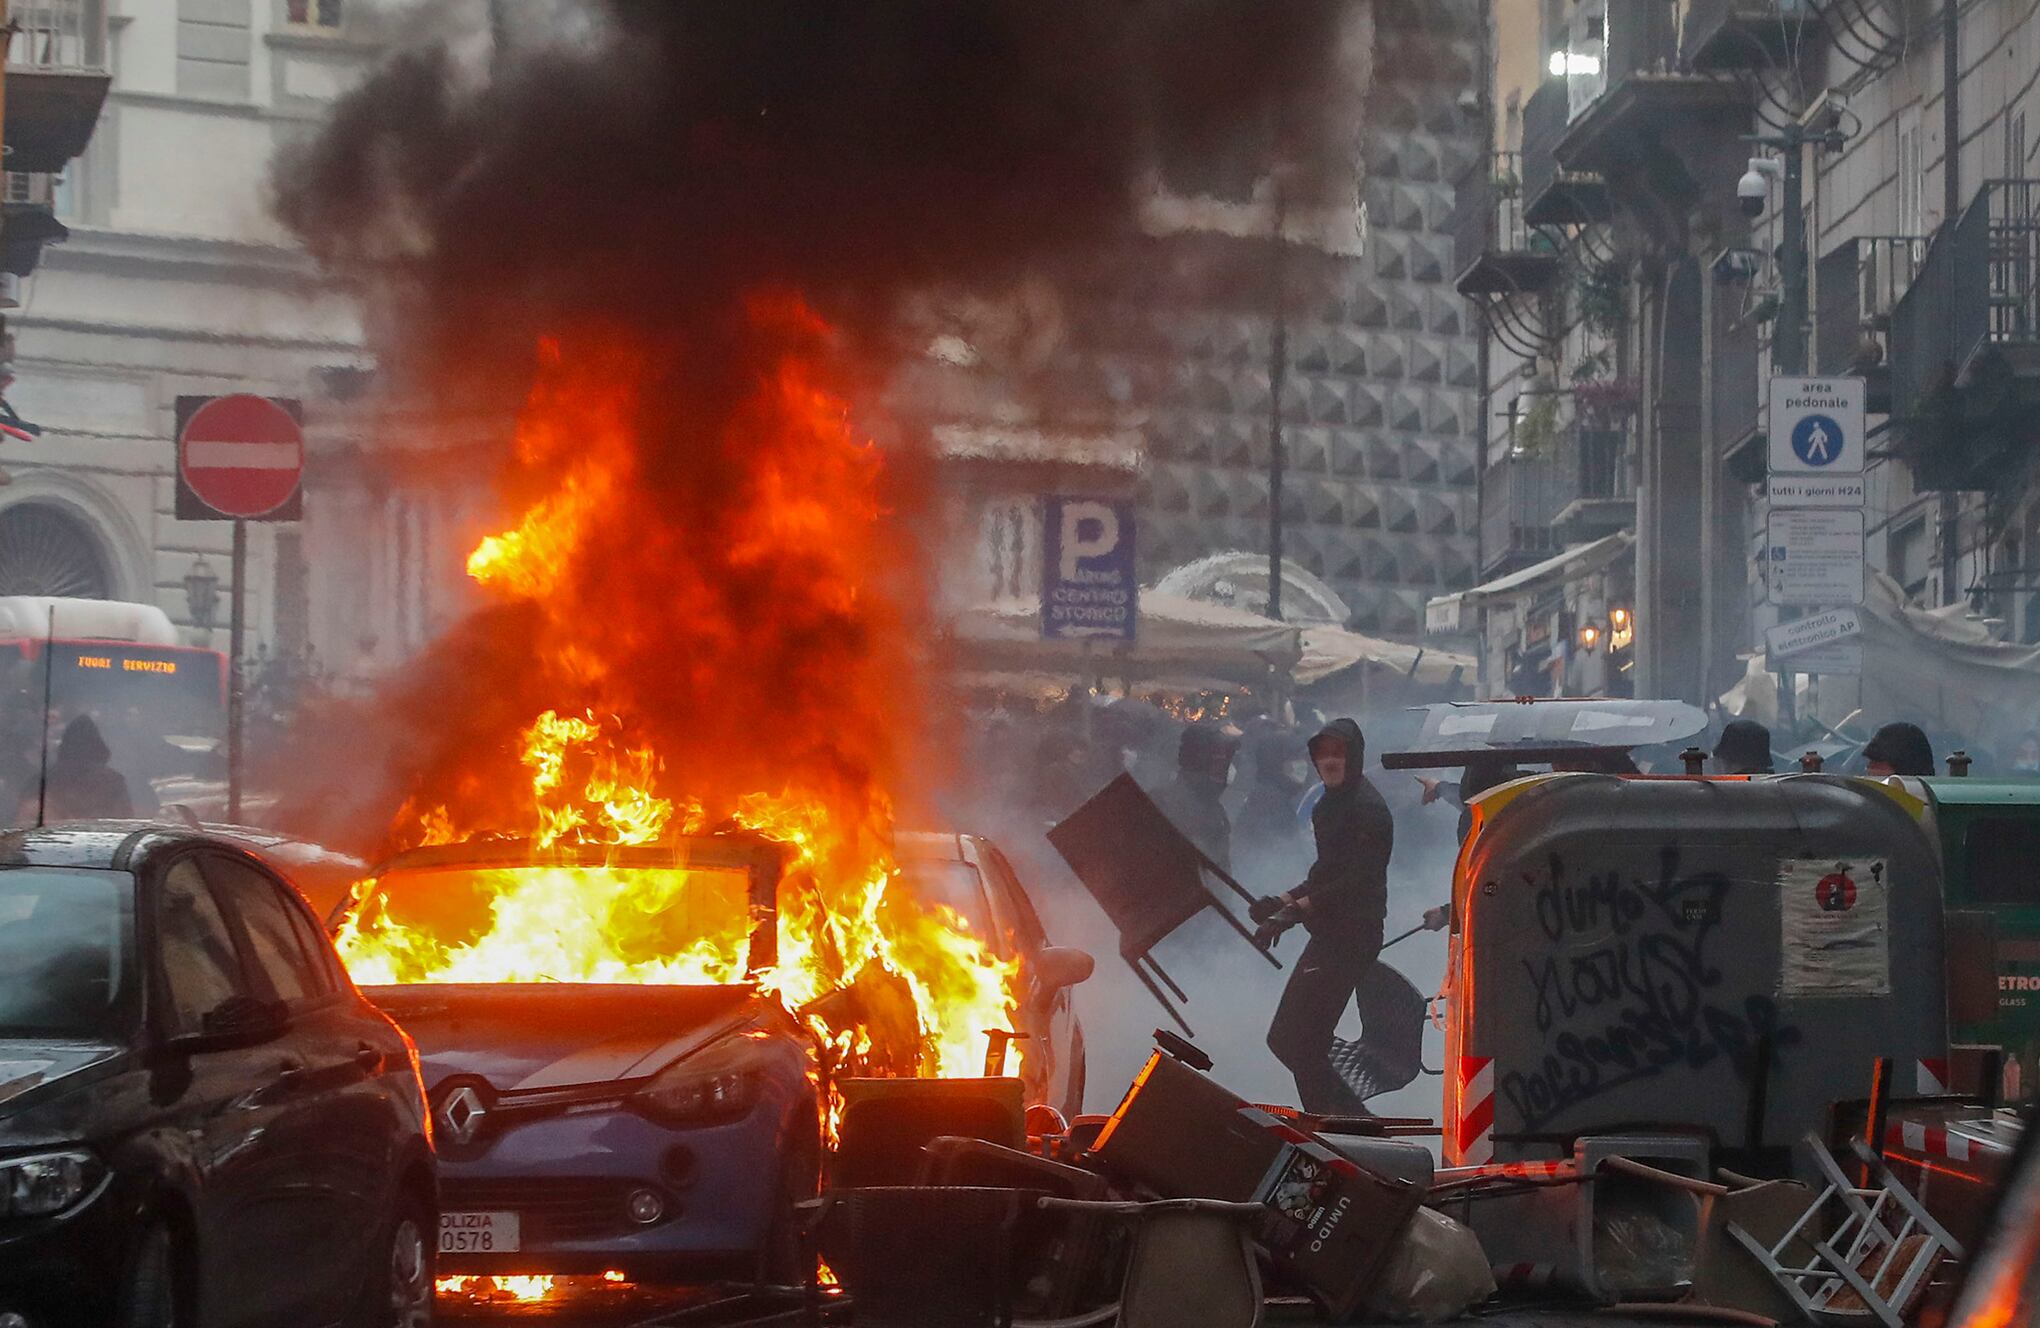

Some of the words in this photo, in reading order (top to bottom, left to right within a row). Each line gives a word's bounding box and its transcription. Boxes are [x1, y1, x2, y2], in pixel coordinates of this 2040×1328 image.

[1802, 383, 1832, 393] area
[1786, 396, 1848, 409] pedonale
[1772, 486, 1795, 496] tutti
[1805, 486, 1834, 497] giorni
[1838, 486, 1861, 496] H24
[1059, 501, 1119, 581] P
[1788, 615, 1837, 634] controllo
[1840, 621, 1855, 633] AP
[1999, 976, 2040, 990] ETRO
[1999, 998, 2026, 1006] GLASS
[440, 1215, 493, 1229] OLIZIA
[1310, 1196, 1351, 1252] UMIDO
[442, 1231, 493, 1251] 0578
